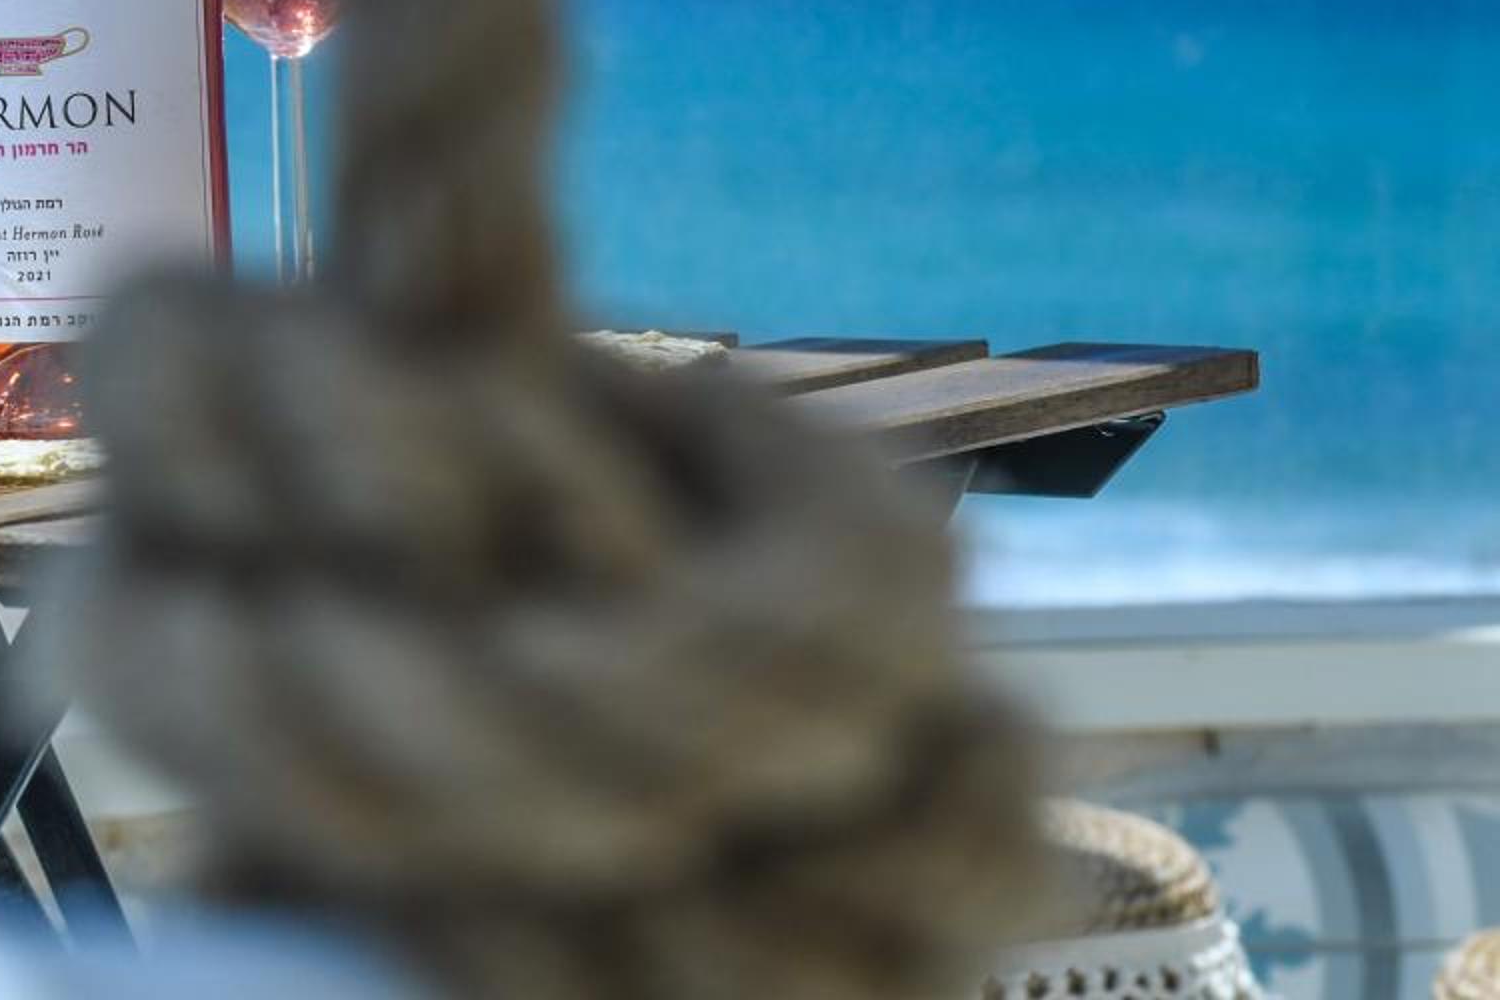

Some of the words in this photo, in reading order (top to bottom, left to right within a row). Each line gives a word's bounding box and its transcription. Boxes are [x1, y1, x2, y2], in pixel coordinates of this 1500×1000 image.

[12, 142, 59, 160] חרמון
[65, 141, 88, 155] הר
[0, 198, 31, 213] הגולן
[35, 198, 63, 209] רמת
[12, 224, 67, 241] Hermon
[7, 250, 37, 262] רוזה
[43, 249, 60, 264] יין
[17, 270, 52, 282] 2021
[27, 314, 61, 327] רמת
